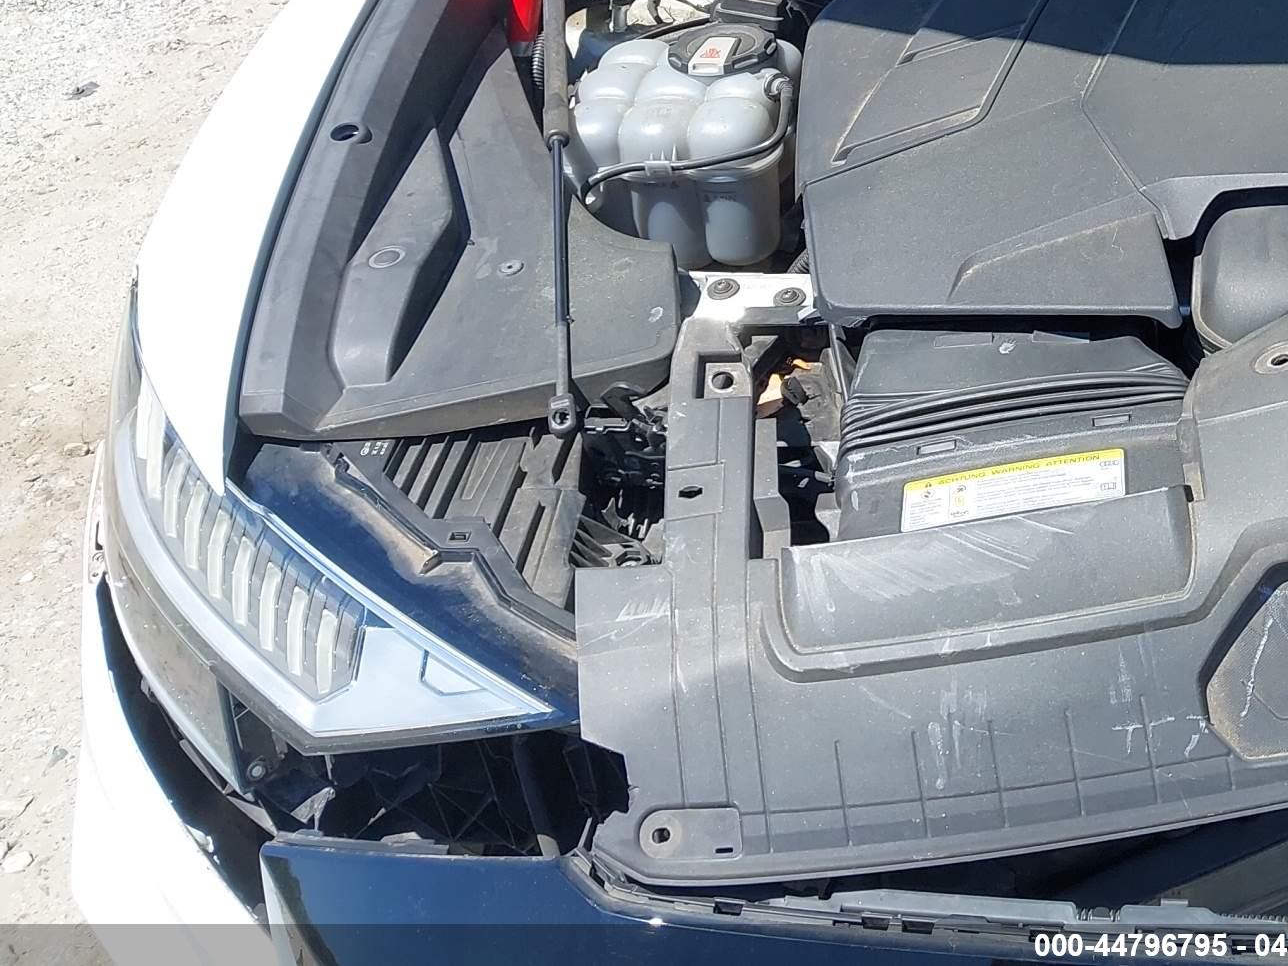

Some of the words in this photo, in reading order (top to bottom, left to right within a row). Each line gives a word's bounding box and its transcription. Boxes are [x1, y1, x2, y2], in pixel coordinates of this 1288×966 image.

[938, 471, 986, 485] ACHTUNG
[991, 463, 1041, 476] WARNING
[1046, 454, 1100, 467] ATTENTION
